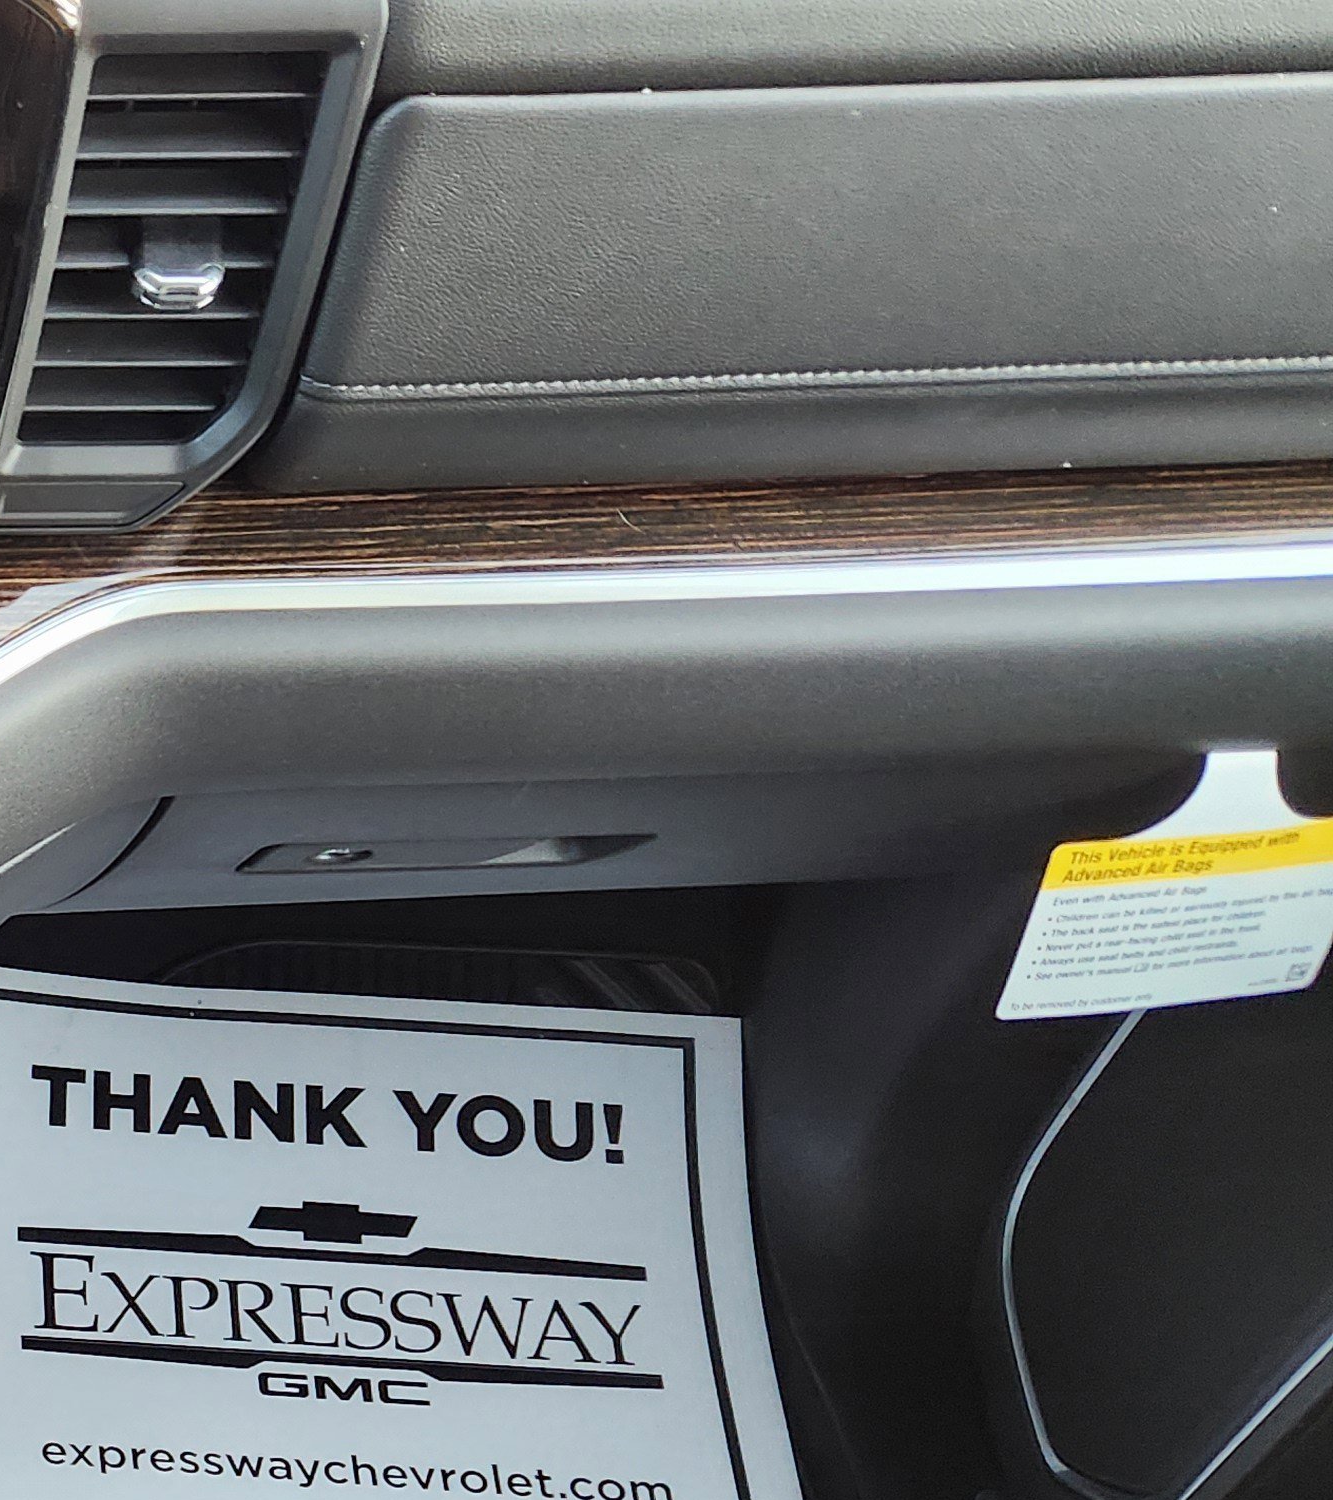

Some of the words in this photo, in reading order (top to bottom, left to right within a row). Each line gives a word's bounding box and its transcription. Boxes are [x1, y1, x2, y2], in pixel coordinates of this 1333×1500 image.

[1071, 851, 1103, 864] This
[1108, 845, 1165, 862] Vehicle
[1169, 842, 1184, 855] is
[1188, 836, 1265, 855] Equipped
[1267, 832, 1300, 847] with
[1062, 864, 1142, 883] Advanced
[1146, 861, 1169, 875] Air
[1172, 860, 1214, 875] Bags
[31, 1064, 366, 1148] THANK
[394, 1090, 625, 1164] YOU!
[257, 1371, 431, 1406] GMC
